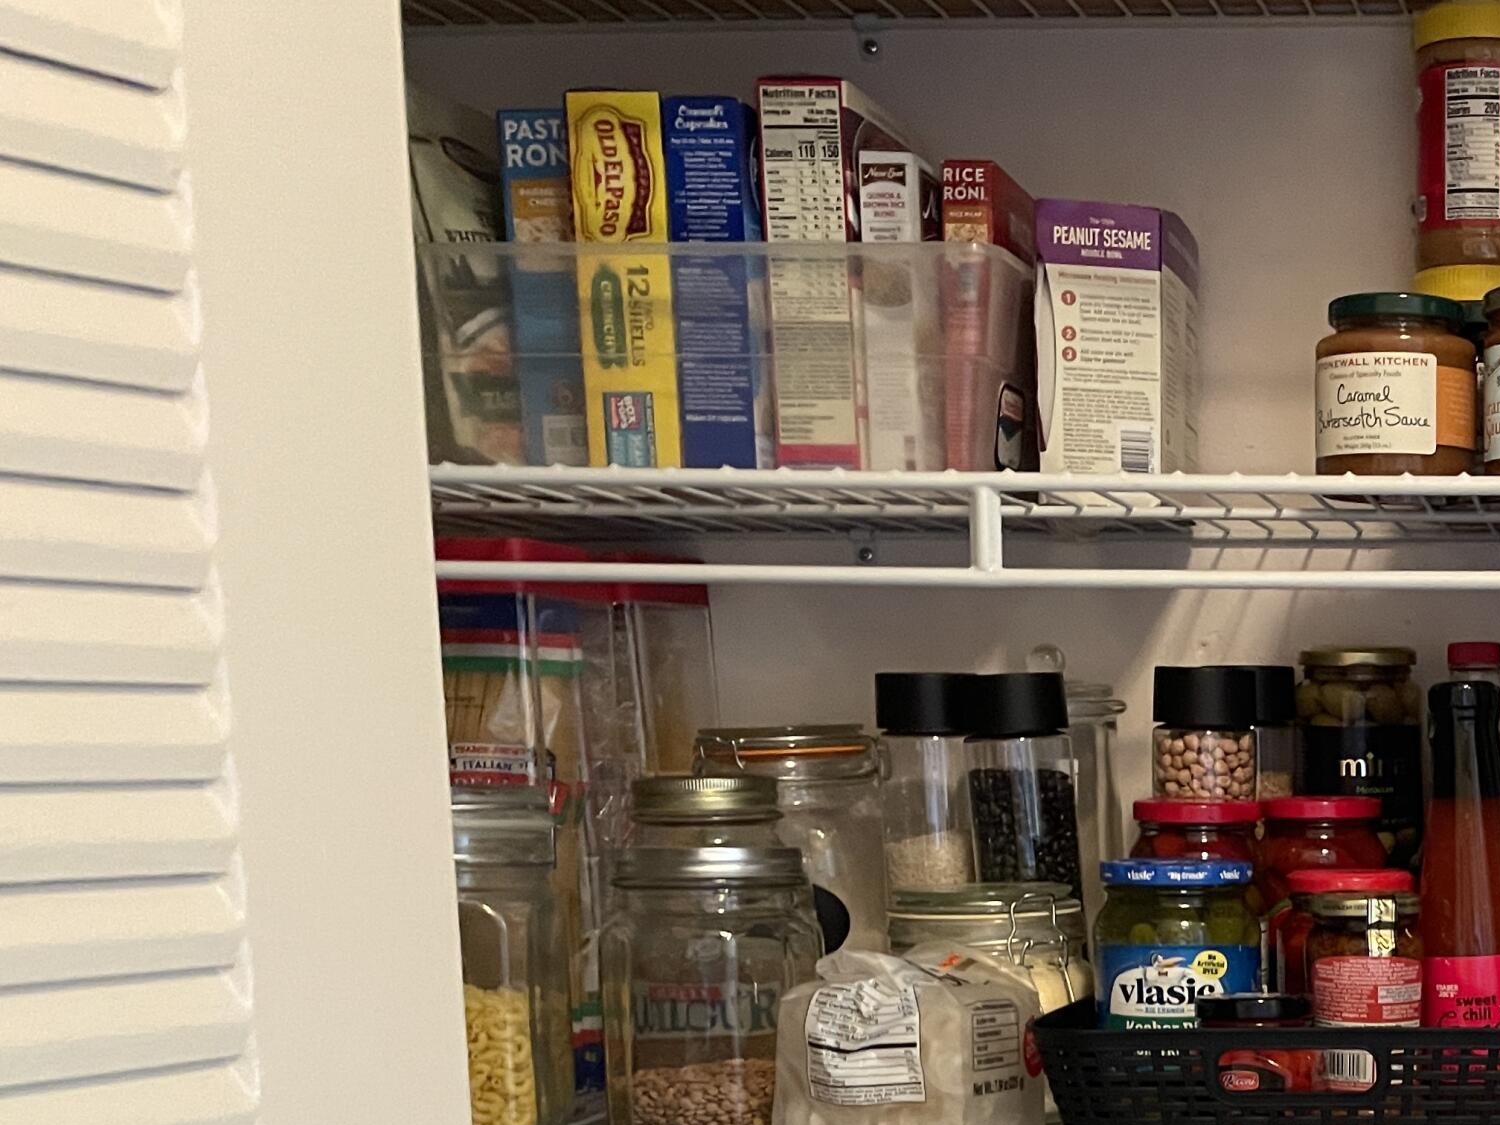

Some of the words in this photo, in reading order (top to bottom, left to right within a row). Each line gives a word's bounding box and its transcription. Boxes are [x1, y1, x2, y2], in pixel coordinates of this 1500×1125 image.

[504, 119, 567, 140] PAST
[506, 143, 569, 168] RON
[943, 168, 985, 183] RICE
[1053, 225, 1100, 246] PEANUT
[1103, 229, 1152, 251] SESAME
[1374, 357, 1429, 367] KITCHEN
[1337, 383, 1394, 405] Caramel
[1383, 406, 1431, 427] Sauce
[462, 759, 513, 771] ITALIAN
[1119, 977, 1216, 1007] vlasic
[1455, 994, 1497, 1007] sweet
[1462, 1007, 1492, 1021] chili
